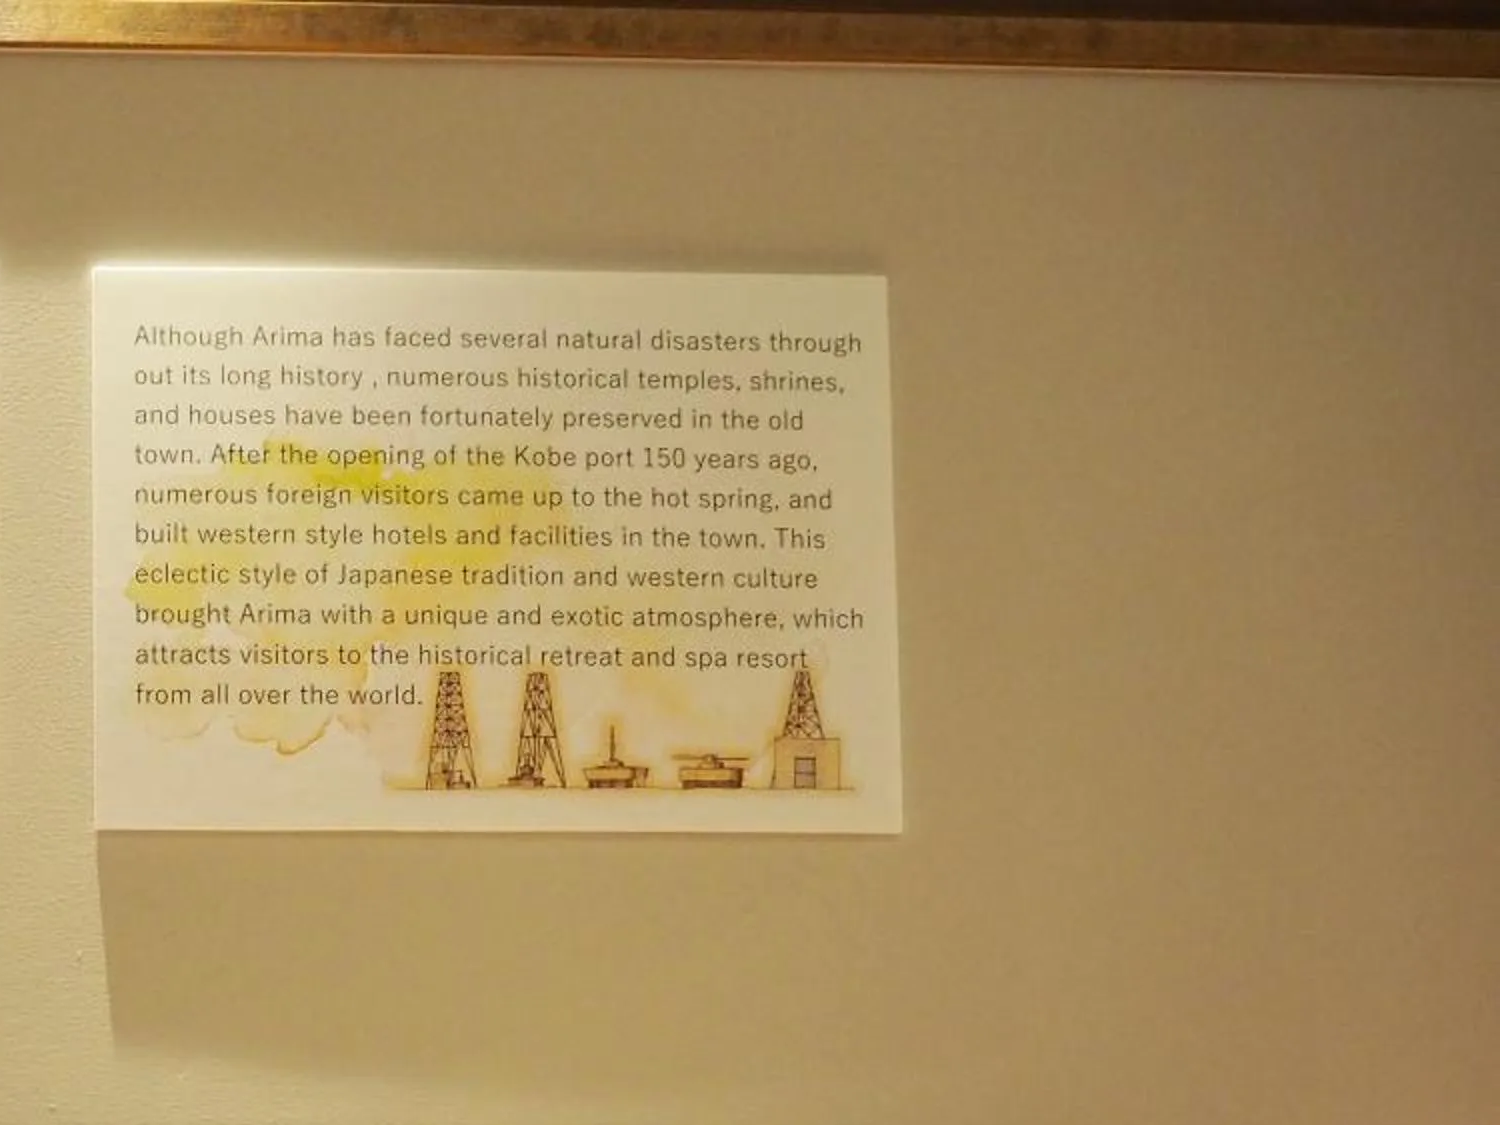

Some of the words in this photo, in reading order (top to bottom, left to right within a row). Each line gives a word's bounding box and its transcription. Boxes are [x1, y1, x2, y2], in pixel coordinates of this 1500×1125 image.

[133, 323, 243, 351] Although
[252, 324, 323, 348] Arima
[332, 325, 376, 348] has
[384, 325, 452, 349] faced
[460, 327, 548, 349] several
[556, 327, 642, 351] natural
[650, 328, 762, 352] disasters
[768, 329, 862, 358] through
[134, 403, 180, 426] and
[188, 403, 277, 426] houses
[284, 403, 344, 426] have
[351, 404, 412, 427] been
[419, 404, 554, 433] fortunately
[562, 406, 683, 433] preserved
[691, 408, 713, 430] in
[720, 408, 760, 431] the
[768, 407, 804, 432] old
[134, 561, 231, 585] eclectic
[238, 562, 298, 591] style
[304, 562, 329, 585] of
[336, 563, 453, 590] Japanese
[461, 563, 564, 588] tradition
[573, 564, 618, 588] and
[626, 567, 725, 589] western
[733, 566, 819, 590] culture
[134, 601, 232, 630] brought
[238, 602, 312, 626] Arima
[320, 602, 373, 625] with
[381, 608, 396, 626] a
[404, 603, 489, 630] unique
[496, 602, 542, 626] and
[550, 605, 625, 628] exotic
[631, 606, 785, 633] atmosphere,
[792, 607, 864, 631] which
[135, 681, 192, 706] from
[200, 682, 230, 705] all
[238, 688, 292, 706] over
[299, 683, 340, 706] the
[347, 682, 424, 706] world.
